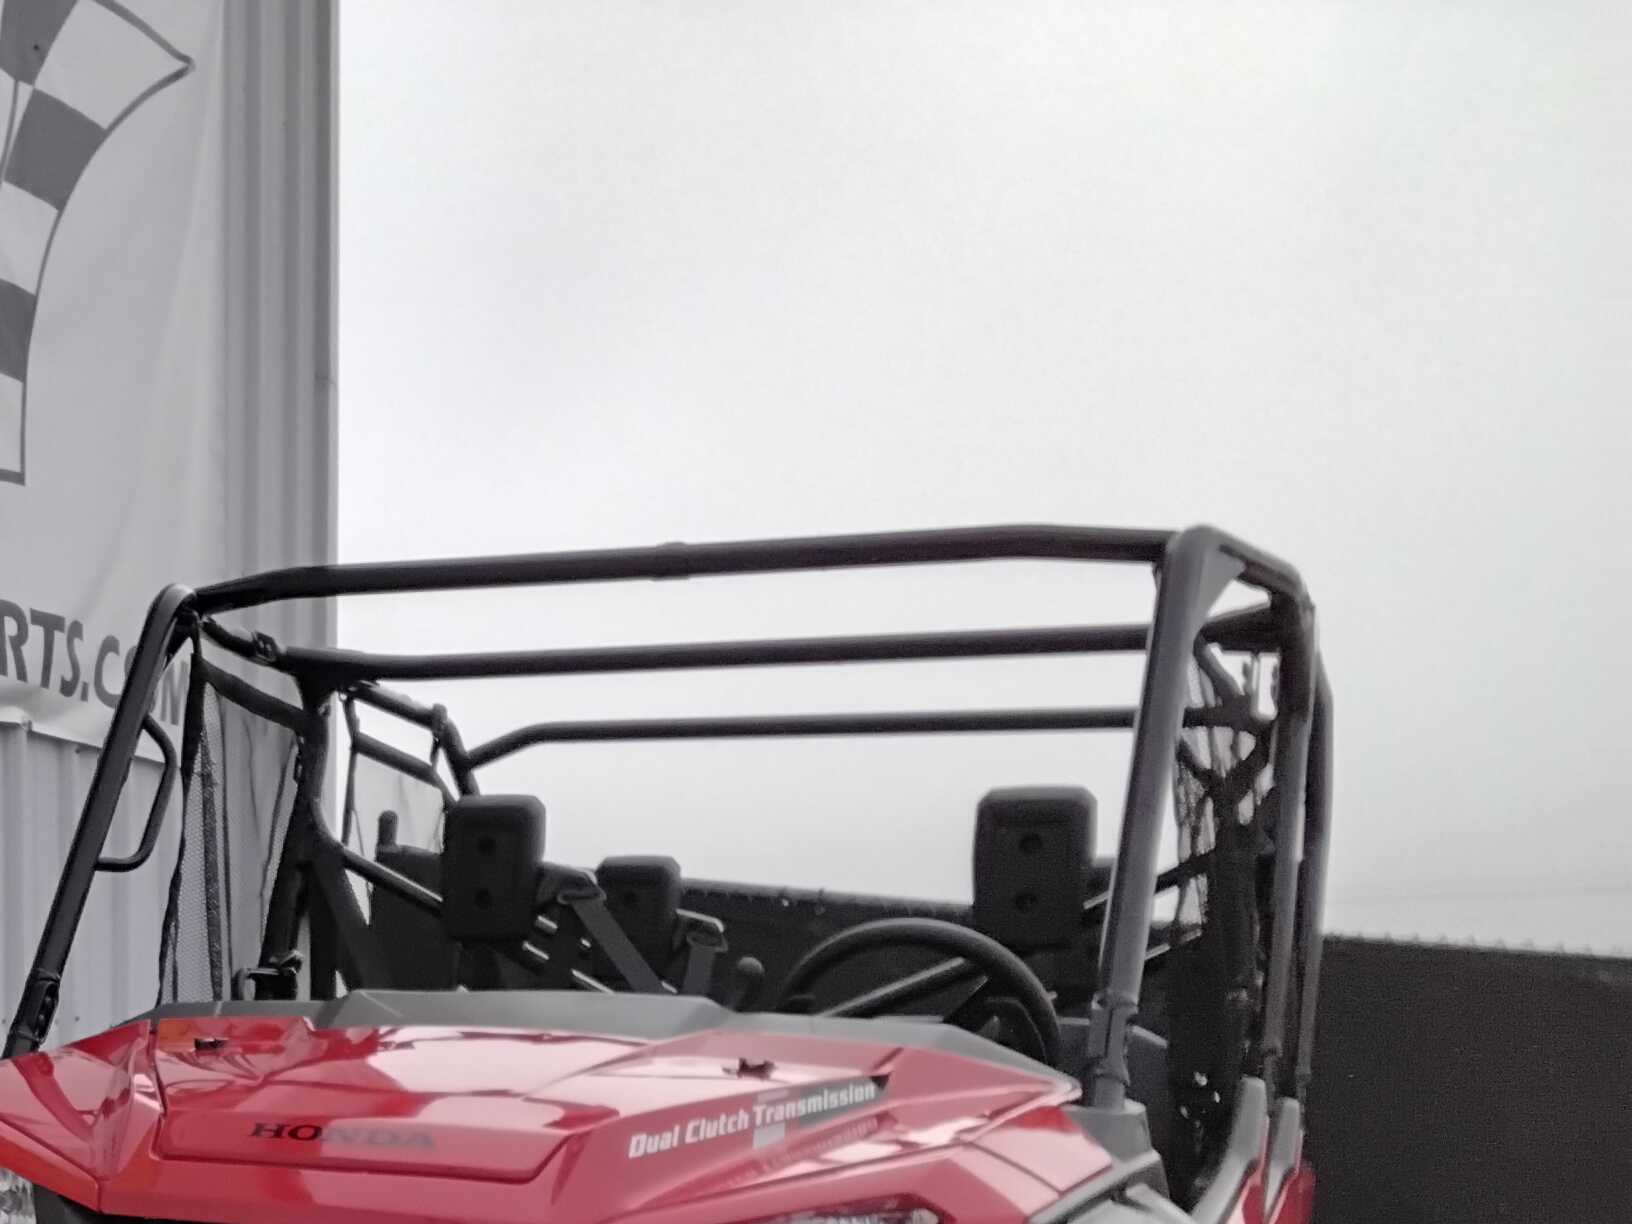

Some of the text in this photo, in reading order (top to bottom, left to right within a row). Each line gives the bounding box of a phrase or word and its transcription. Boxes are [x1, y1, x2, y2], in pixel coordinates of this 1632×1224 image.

[247, 1122, 436, 1150] HONDA
[628, 1125, 679, 1159] Dual
[684, 1109, 750, 1144] Clutch
[752, 1083, 876, 1127] Transmission
